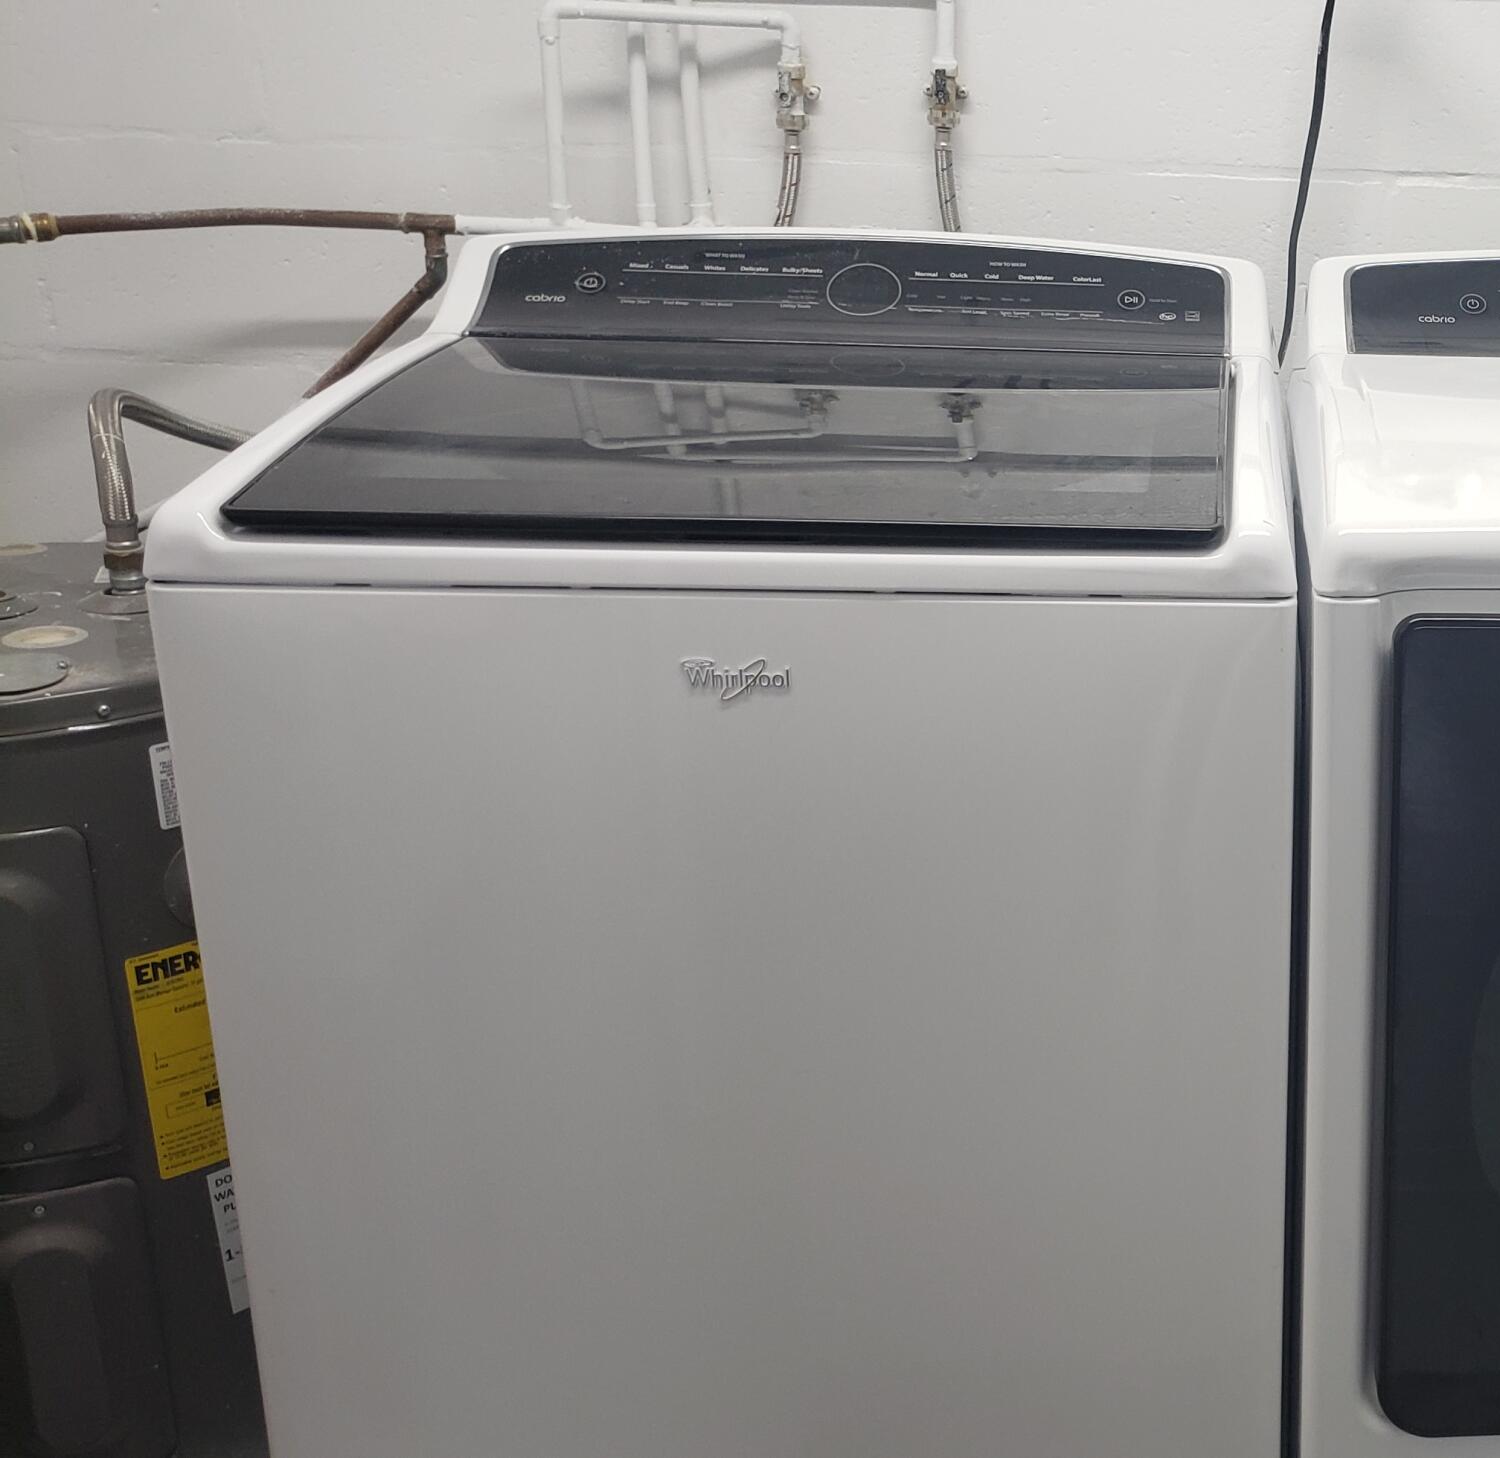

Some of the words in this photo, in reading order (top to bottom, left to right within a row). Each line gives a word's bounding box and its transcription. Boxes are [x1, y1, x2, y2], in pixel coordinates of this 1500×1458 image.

[525, 294, 566, 303] cabrio
[1418, 314, 1456, 323] cabrio
[682, 660, 791, 698] Whirlpool
[134, 950, 200, 985] ENER
